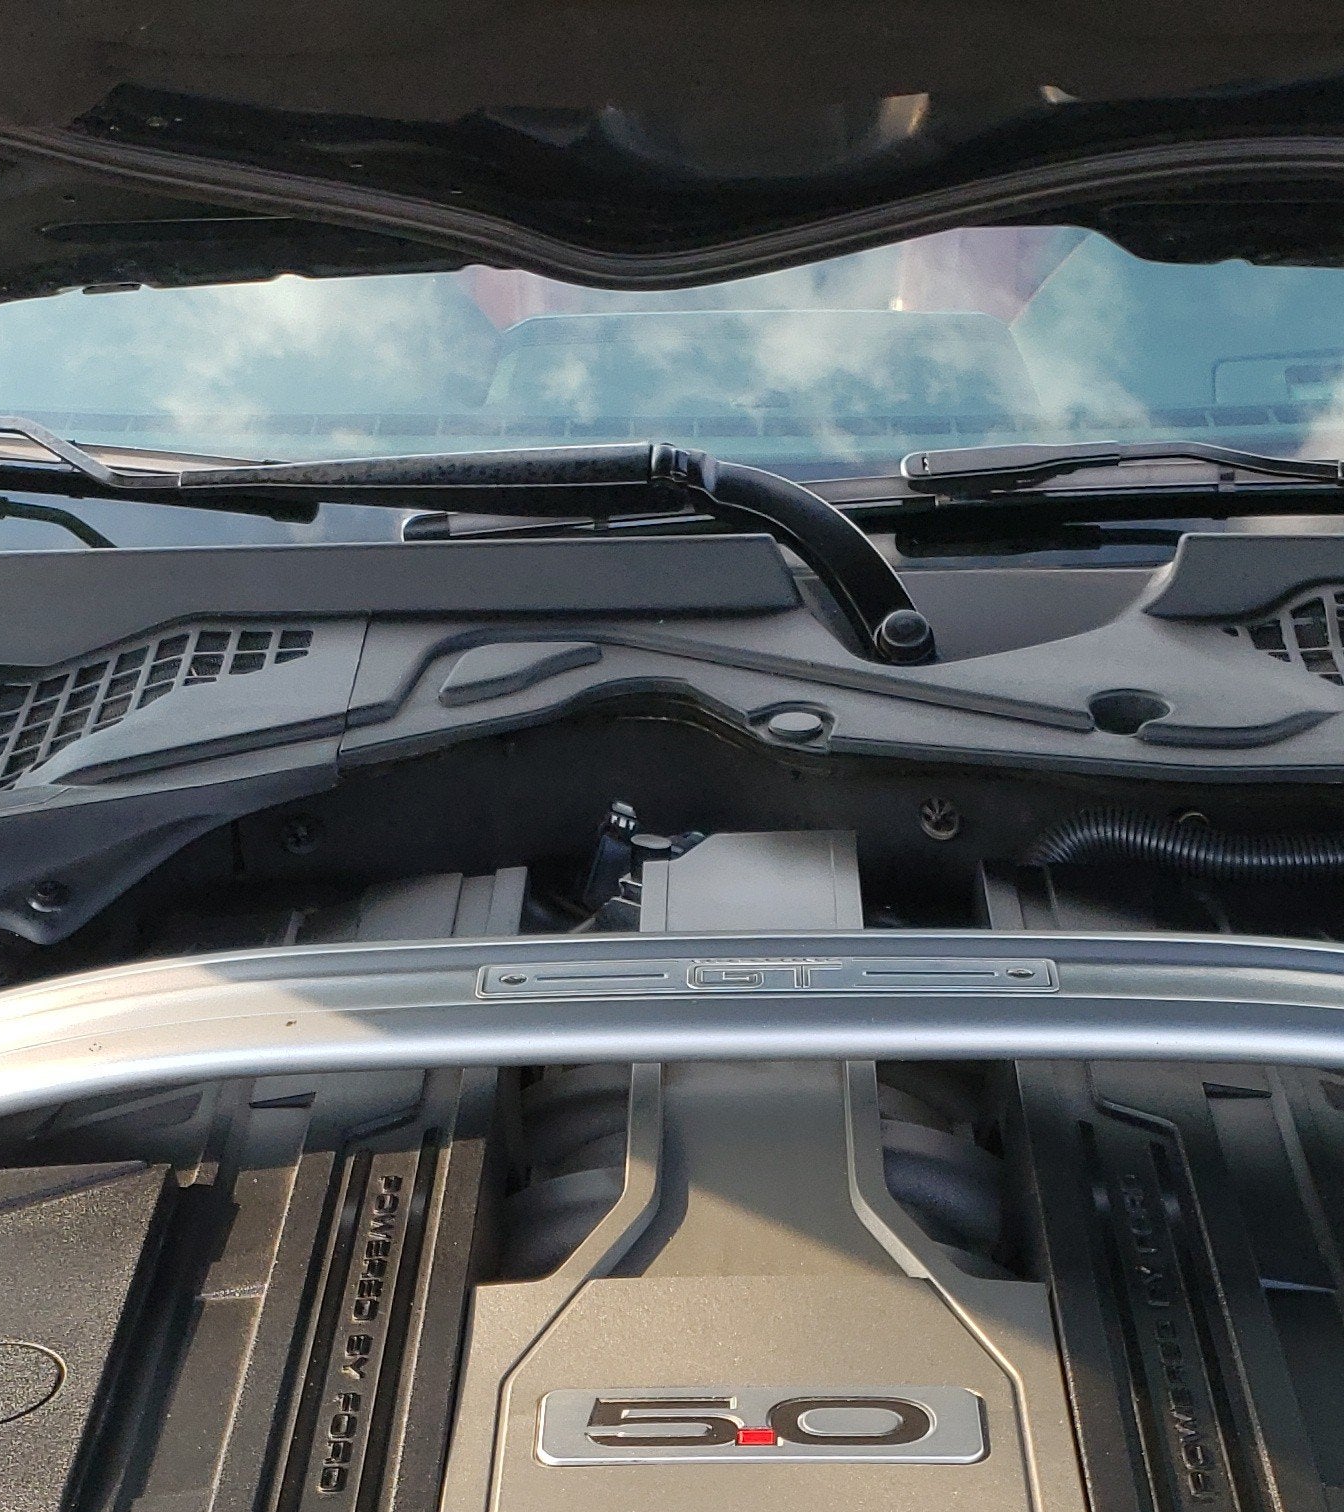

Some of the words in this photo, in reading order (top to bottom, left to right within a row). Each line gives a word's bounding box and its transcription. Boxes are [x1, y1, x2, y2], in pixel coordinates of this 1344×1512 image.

[687, 962, 843, 989] GT
[352, 1174, 404, 1323] POWERED
[340, 1333, 374, 1381] BY
[317, 1391, 362, 1493] FORD
[583, 1396, 937, 1447] 5.0
